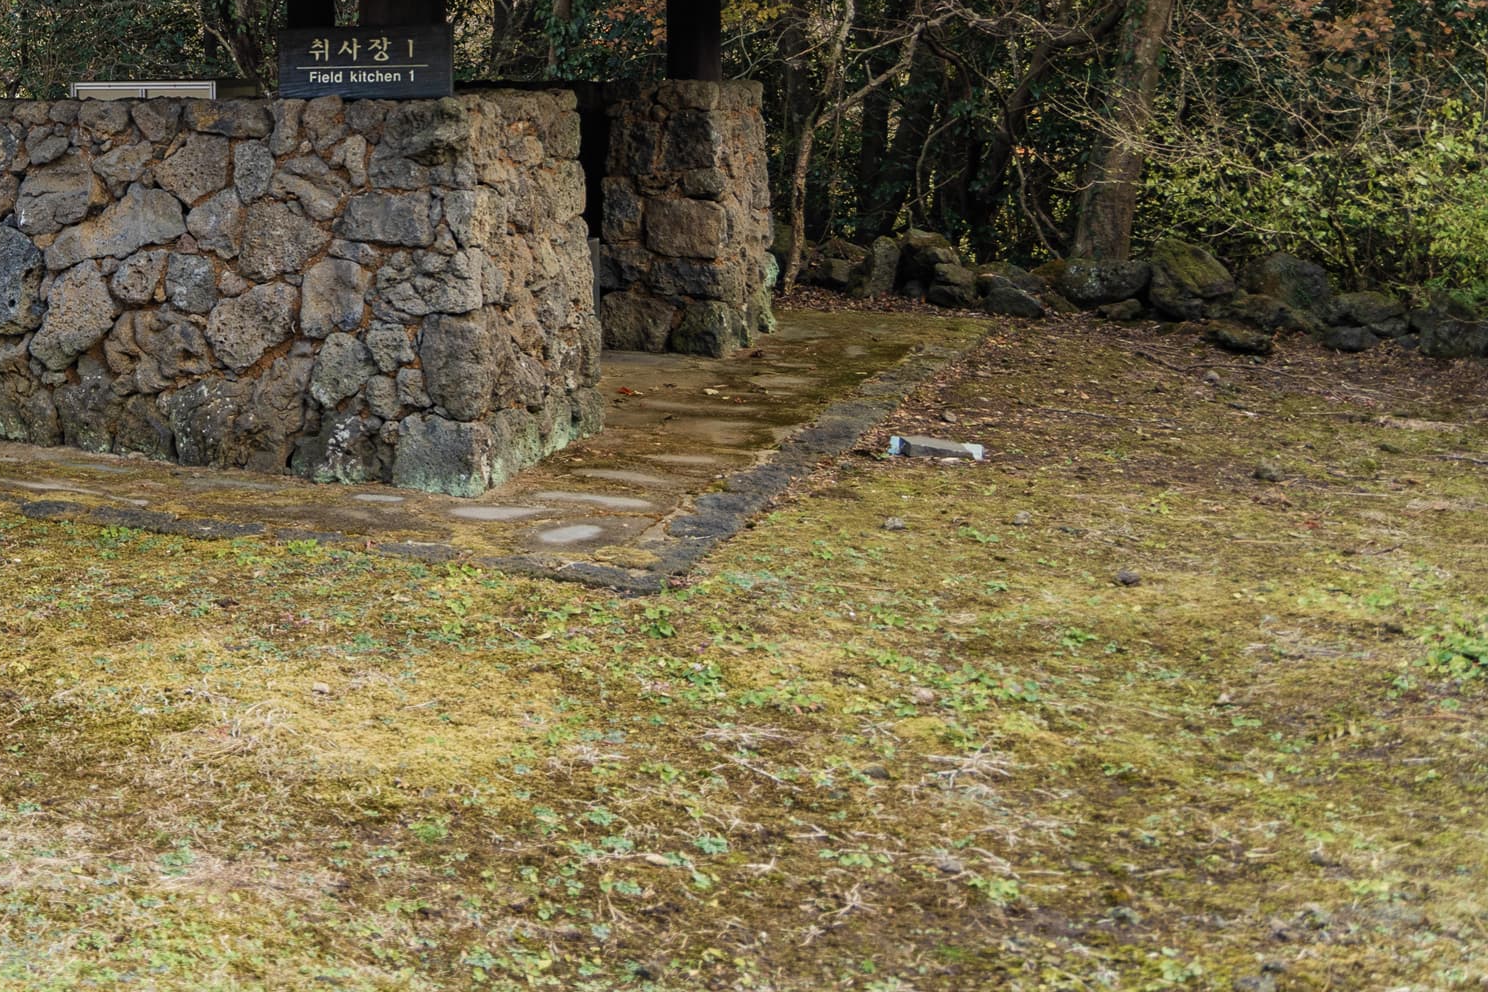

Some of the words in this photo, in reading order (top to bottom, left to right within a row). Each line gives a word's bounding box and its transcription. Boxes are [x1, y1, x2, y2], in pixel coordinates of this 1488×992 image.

[308, 37, 392, 62] 취사장
[309, 71, 343, 83] Field
[350, 70, 401, 83] kitchen
[408, 70, 415, 82] 1
